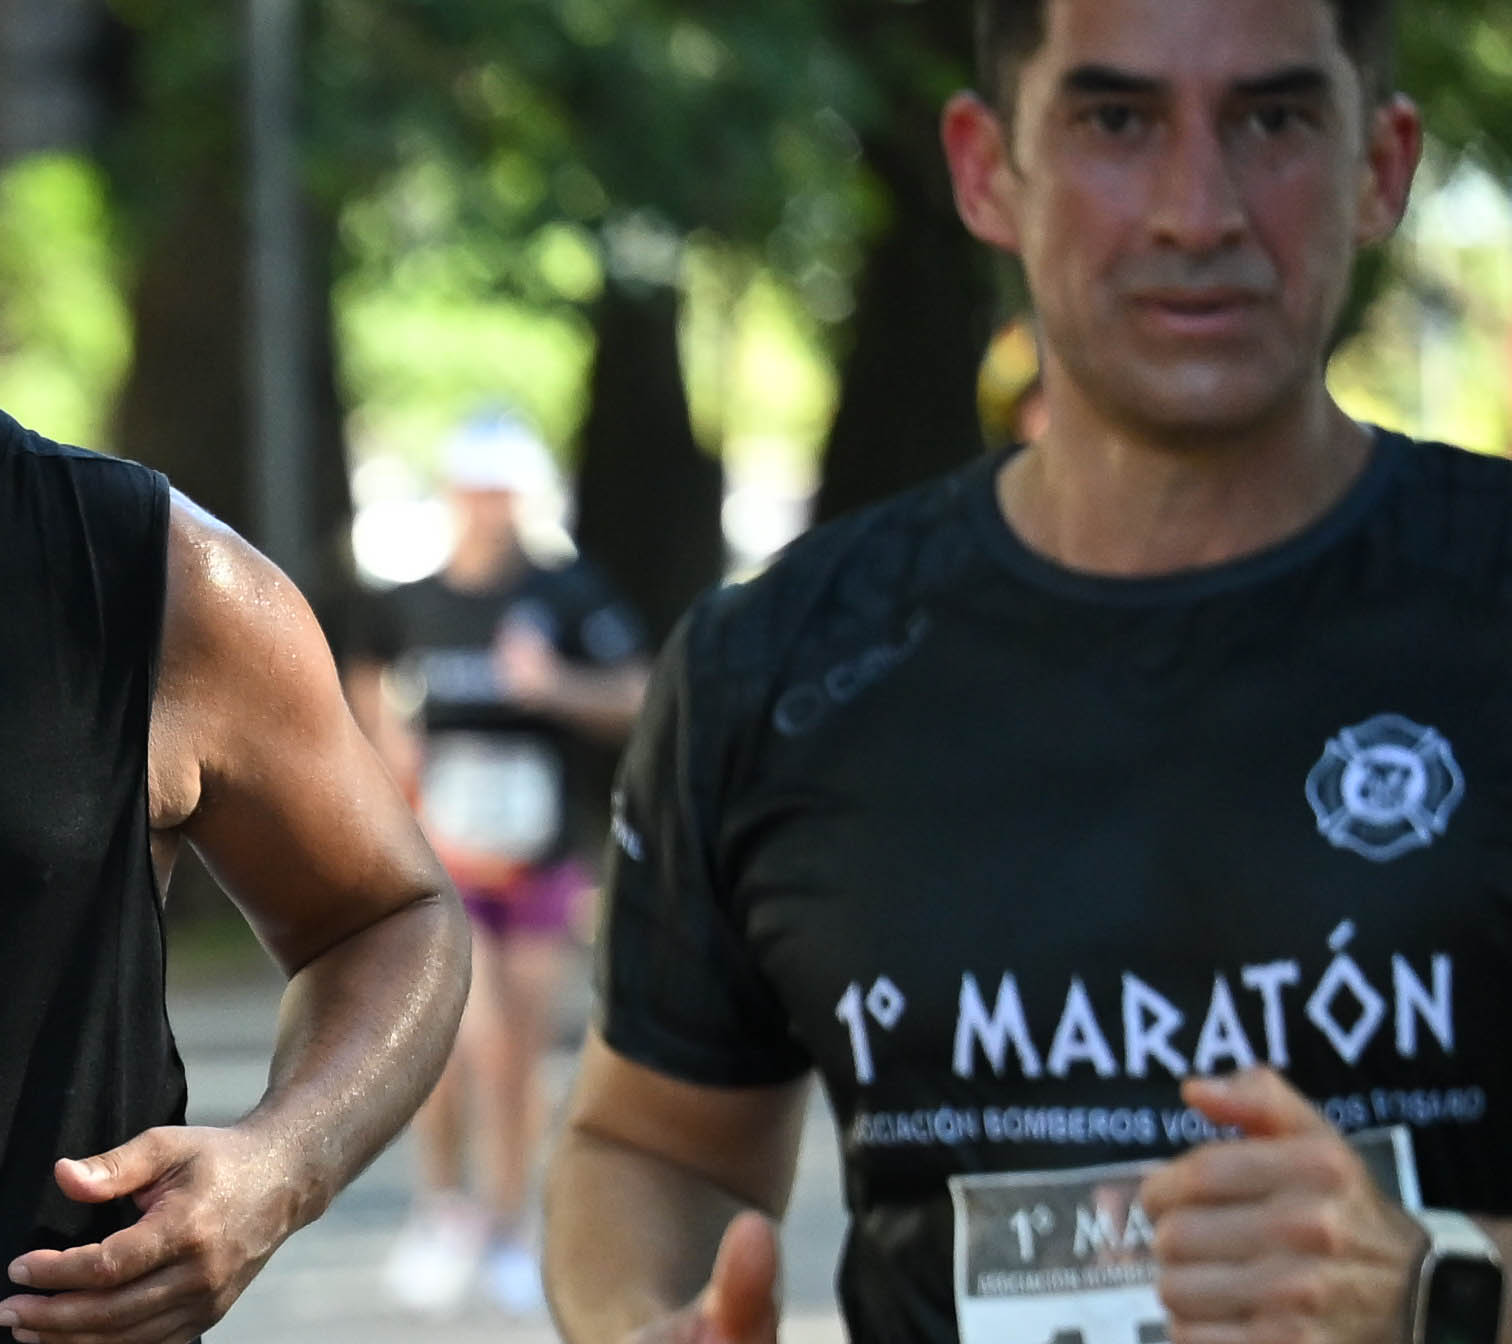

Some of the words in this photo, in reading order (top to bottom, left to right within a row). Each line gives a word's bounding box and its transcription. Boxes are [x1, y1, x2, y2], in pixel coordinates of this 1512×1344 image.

[951, 918, 1455, 1082] MARATÓN
[982, 1105, 1158, 1145] BOMBEROS
[1072, 1200, 1156, 1257] MA
